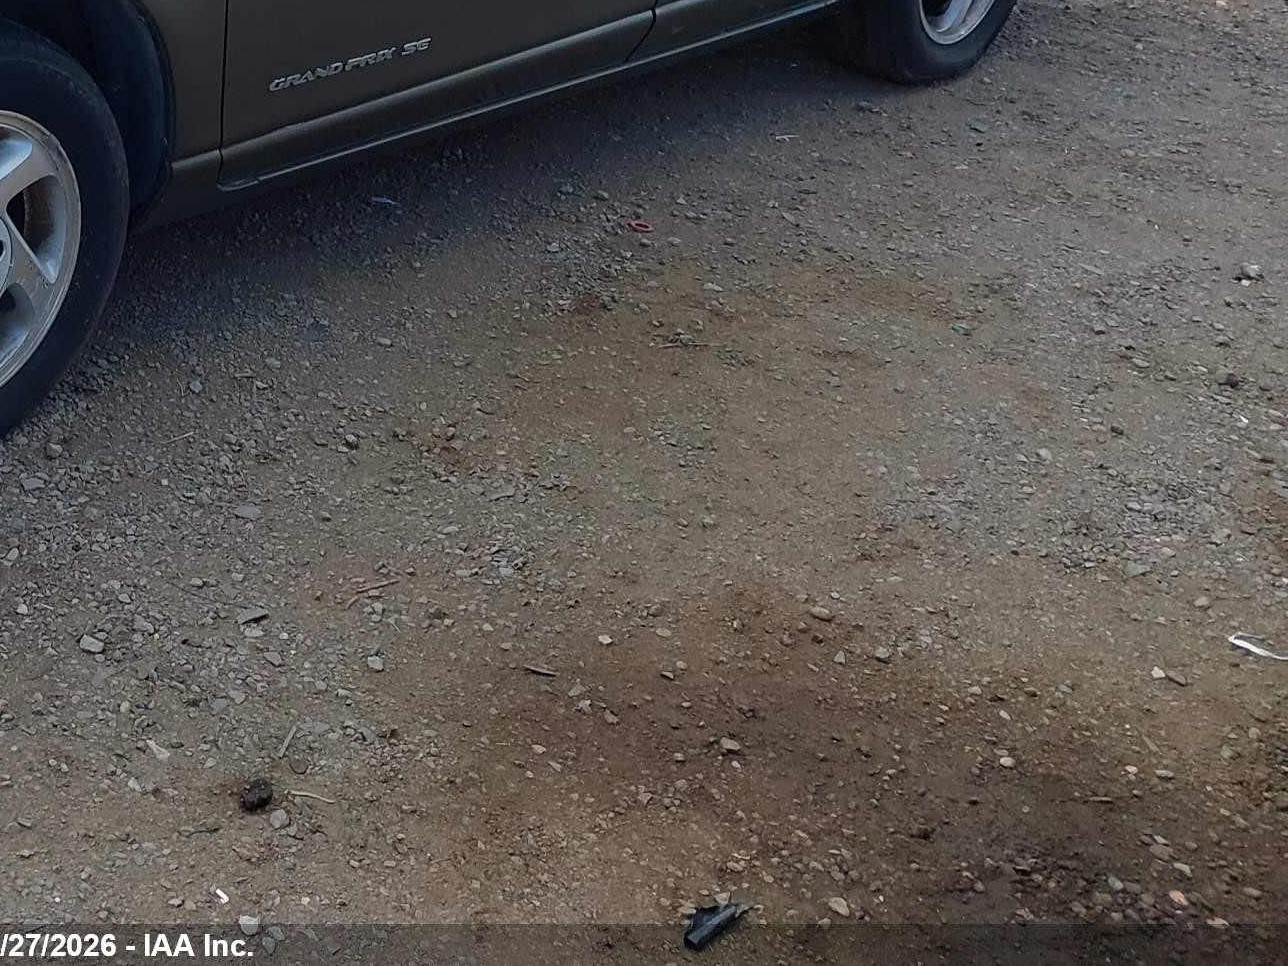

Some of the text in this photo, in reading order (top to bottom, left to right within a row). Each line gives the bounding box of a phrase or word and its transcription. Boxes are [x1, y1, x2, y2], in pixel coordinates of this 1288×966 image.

[269, 37, 432, 92] GRAND PRIX SE
